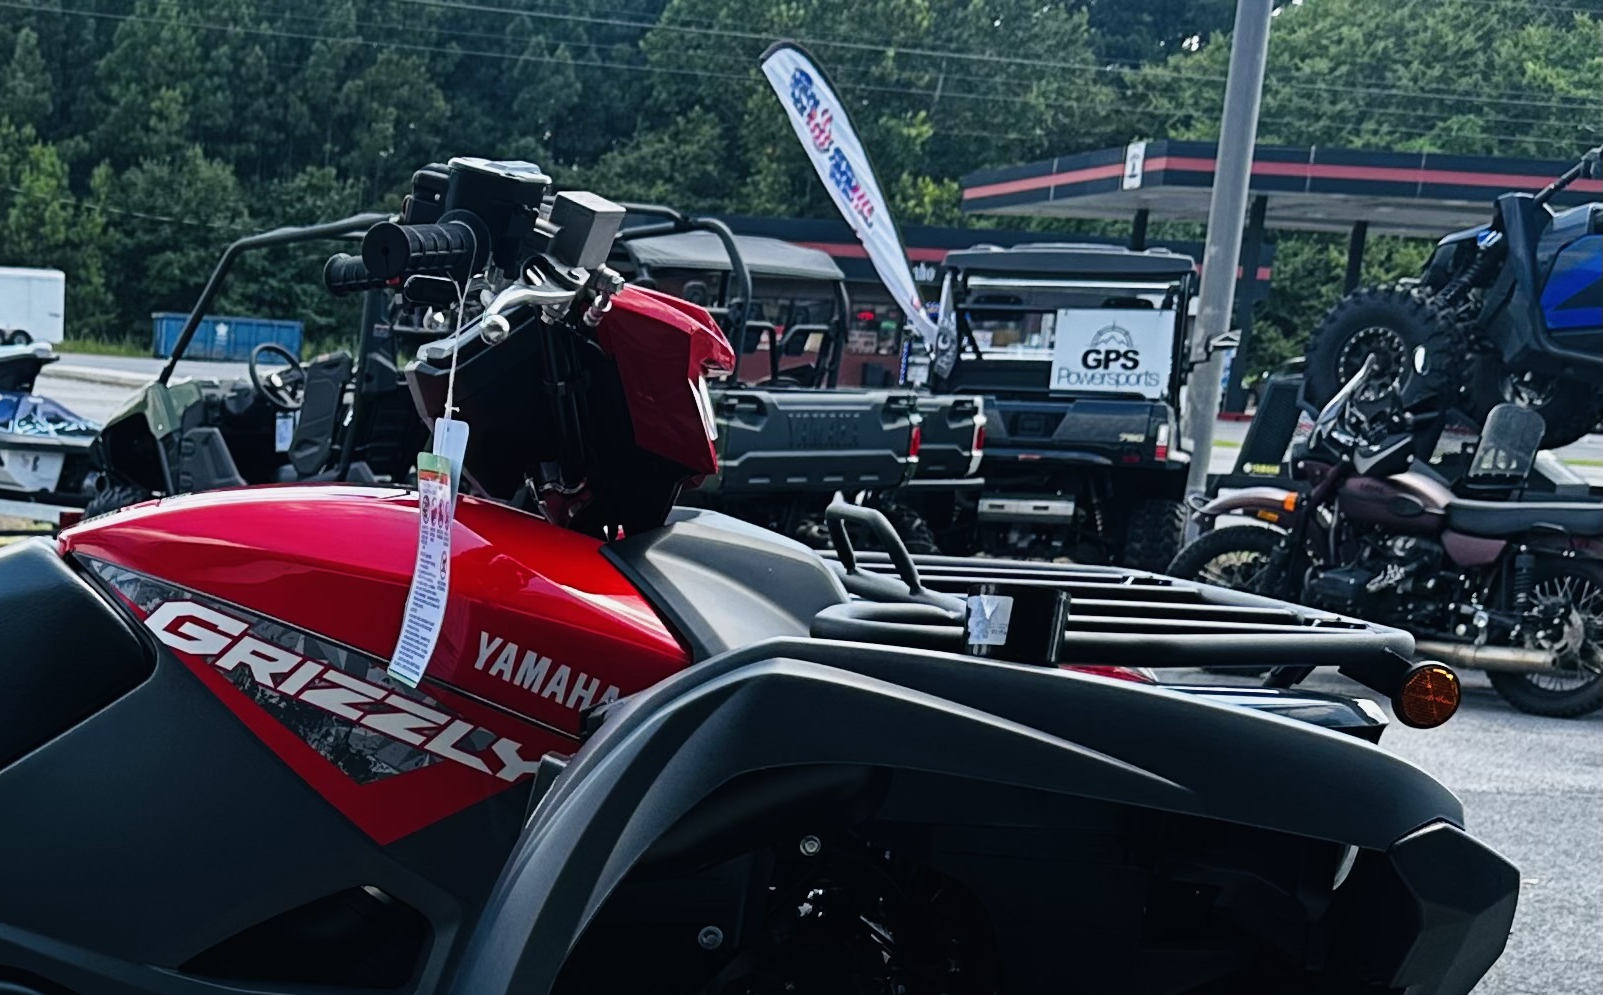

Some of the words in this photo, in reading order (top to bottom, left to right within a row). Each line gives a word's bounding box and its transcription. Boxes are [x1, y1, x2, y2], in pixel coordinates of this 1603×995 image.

[1081, 349, 1140, 371] GPS
[1057, 367, 1160, 388] Powersports
[144, 601, 541, 783] GRIZZLY
